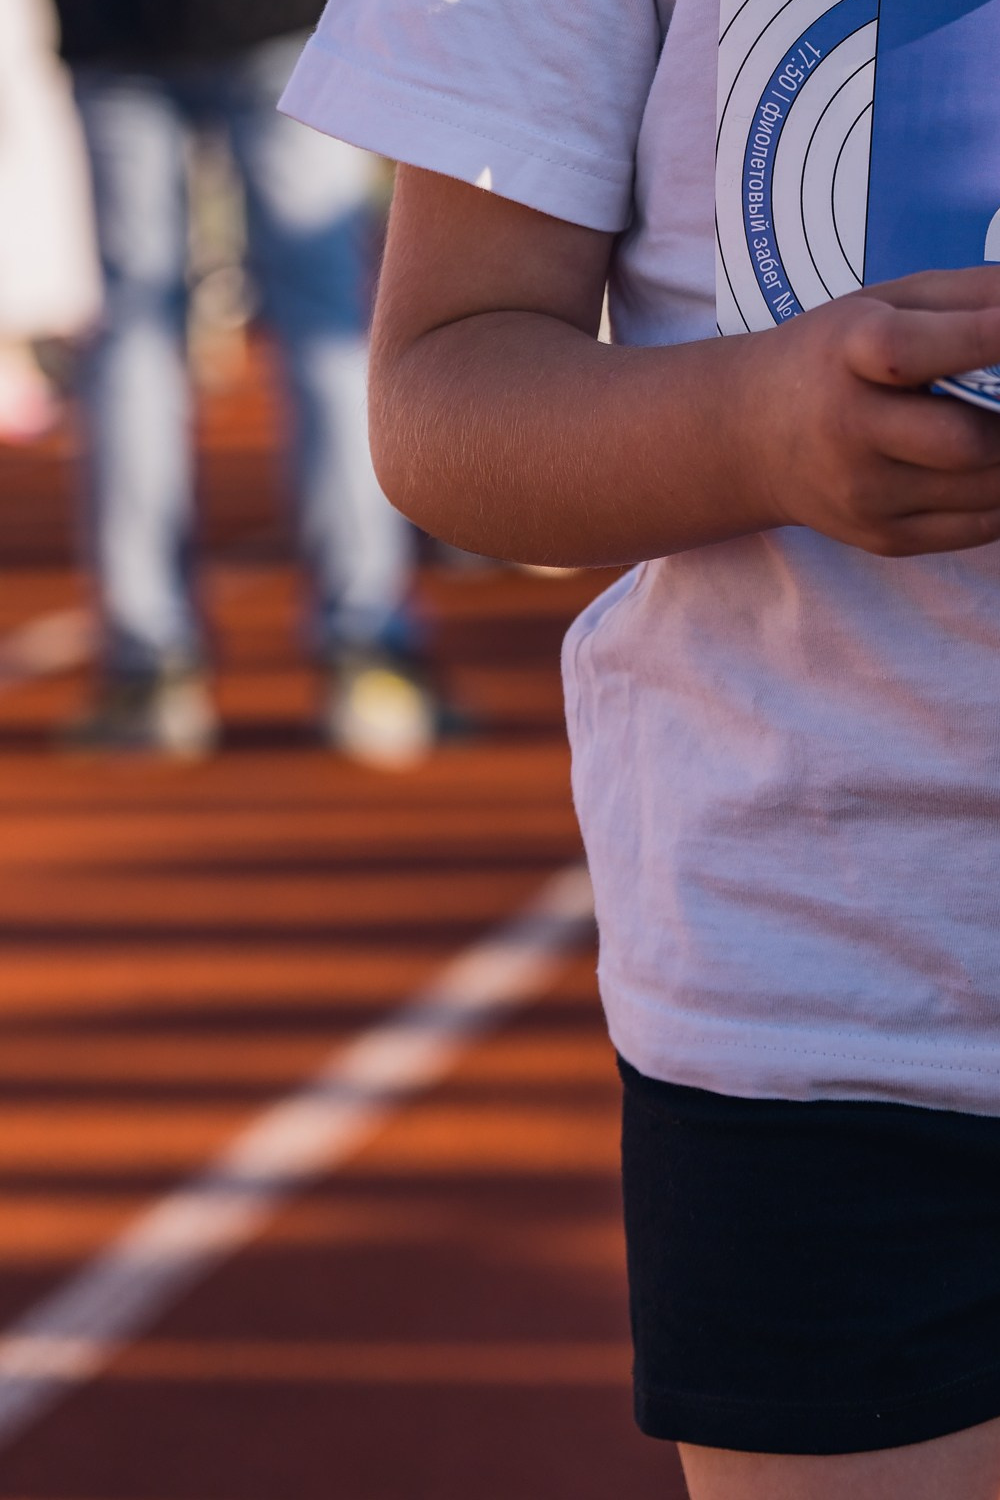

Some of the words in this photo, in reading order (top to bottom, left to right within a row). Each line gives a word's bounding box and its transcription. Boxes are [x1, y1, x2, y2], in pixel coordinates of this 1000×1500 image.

[778, 41, 821, 92] 17:50
[748, 101, 783, 233] фиолетовый
[753, 237, 782, 289] забег
